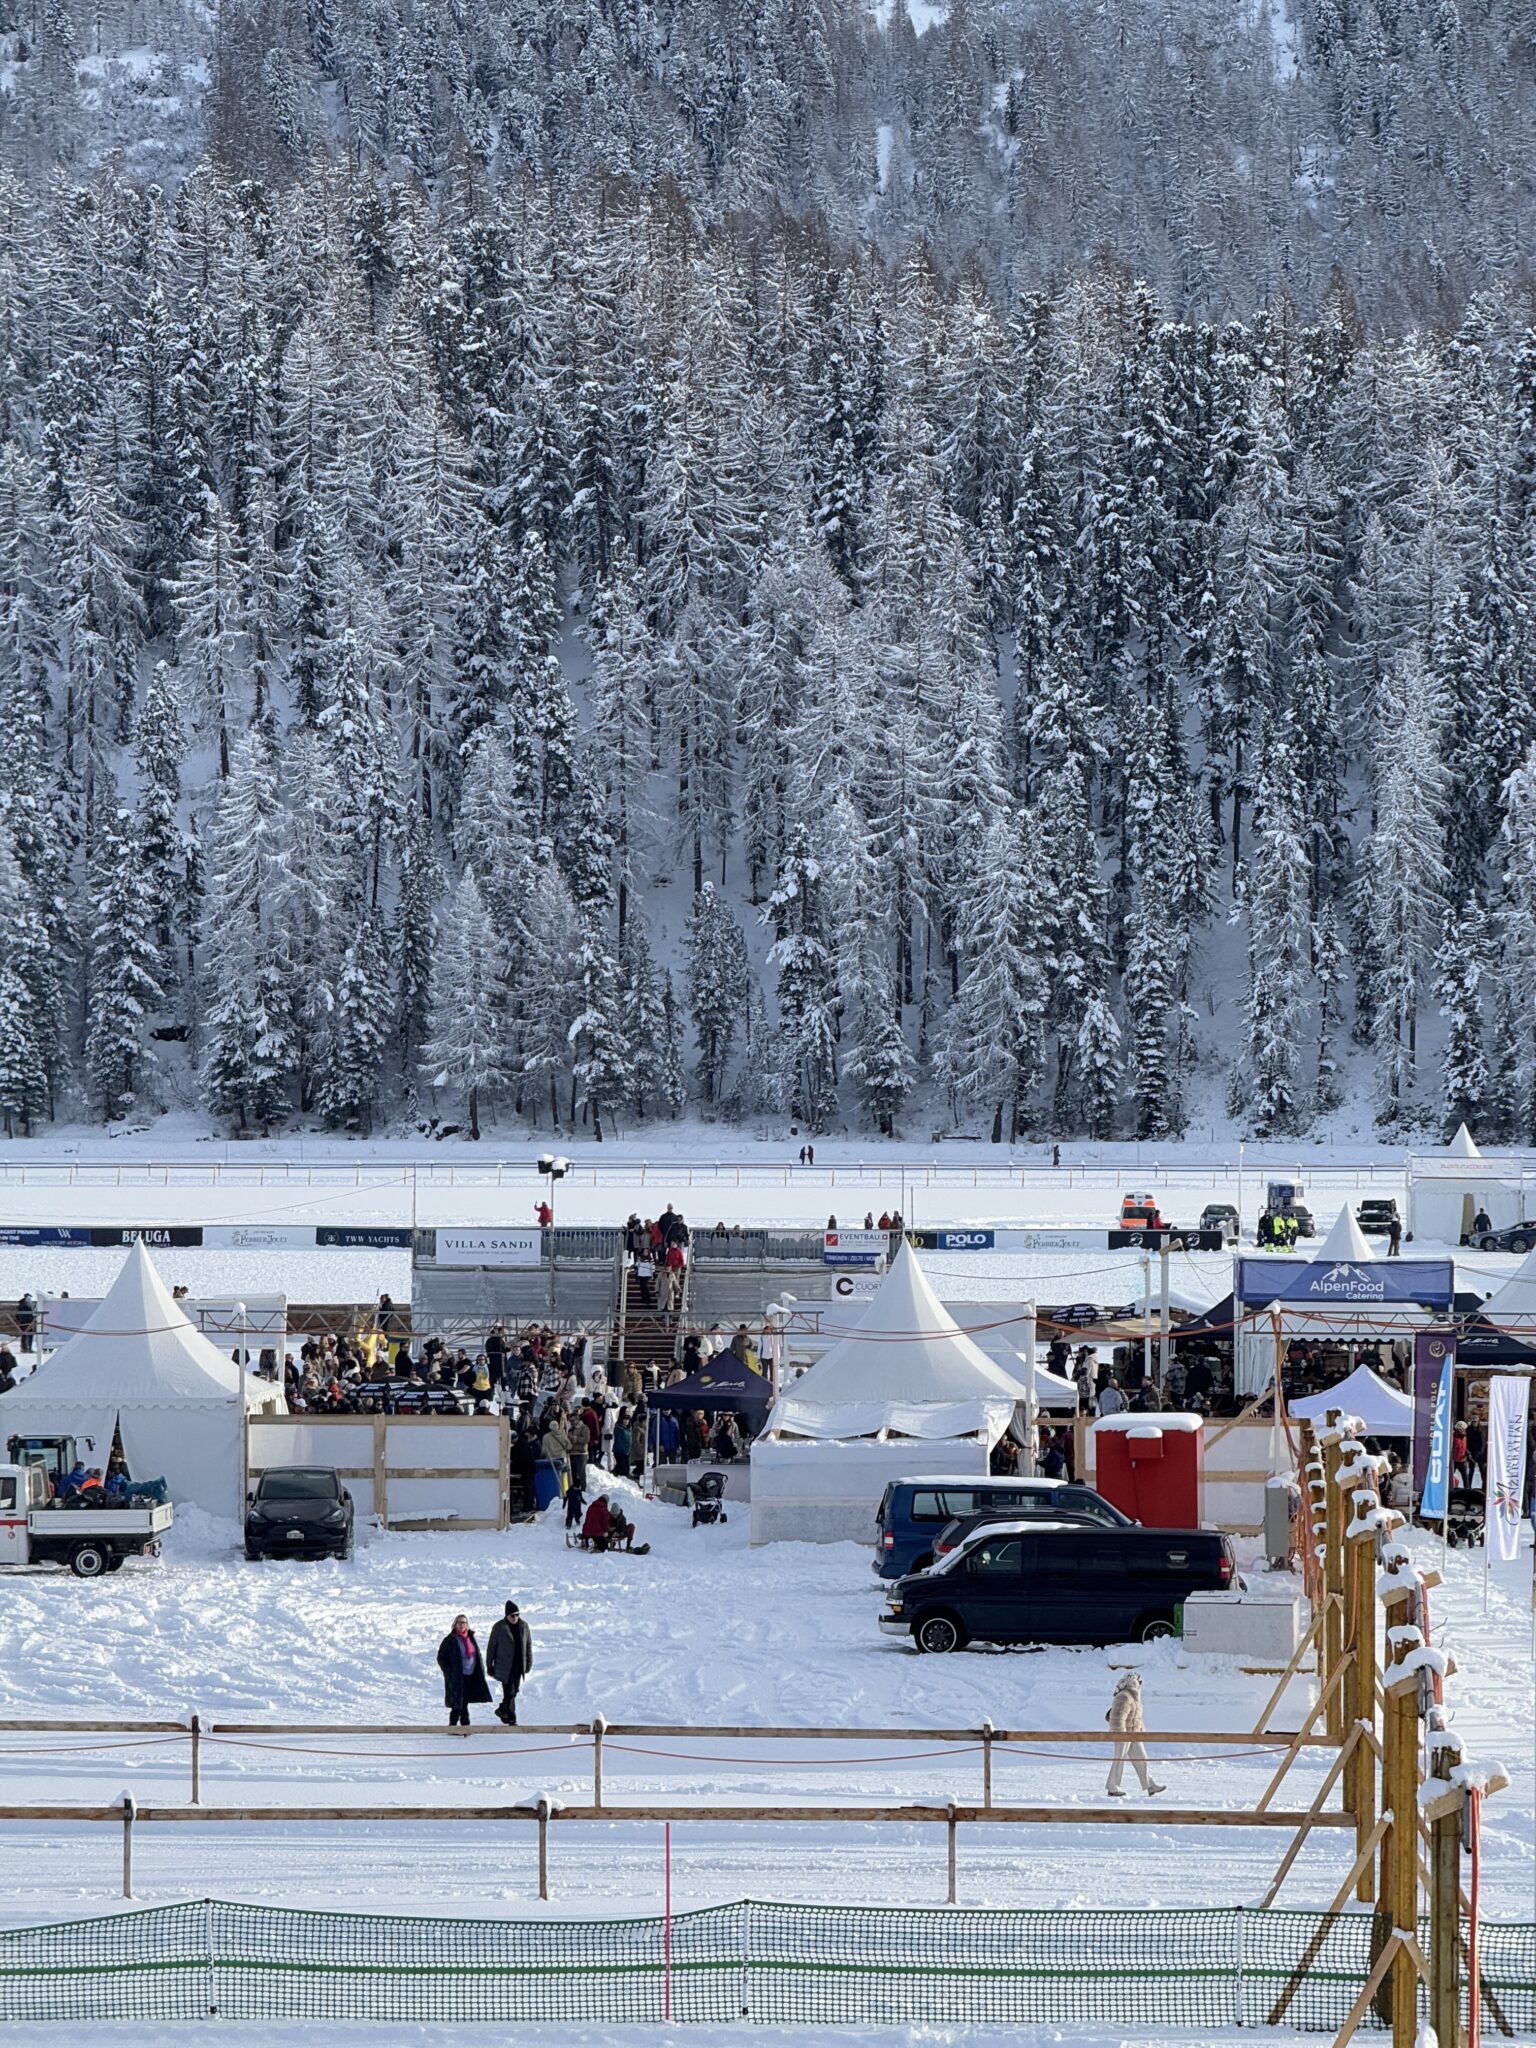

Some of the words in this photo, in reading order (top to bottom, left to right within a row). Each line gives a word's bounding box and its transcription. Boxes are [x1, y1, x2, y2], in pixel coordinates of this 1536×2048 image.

[122, 1230, 171, 1243] BELUGA
[368, 1235, 400, 1243] YACHTS
[945, 1234, 987, 1244] POLO
[444, 1240, 486, 1249] VILLA
[490, 1240, 533, 1249] SANDI
[1309, 1280, 1384, 1294] AlpenFood
[1345, 1292, 1384, 1301] Catering
[1430, 1381, 1438, 1408] POLO
